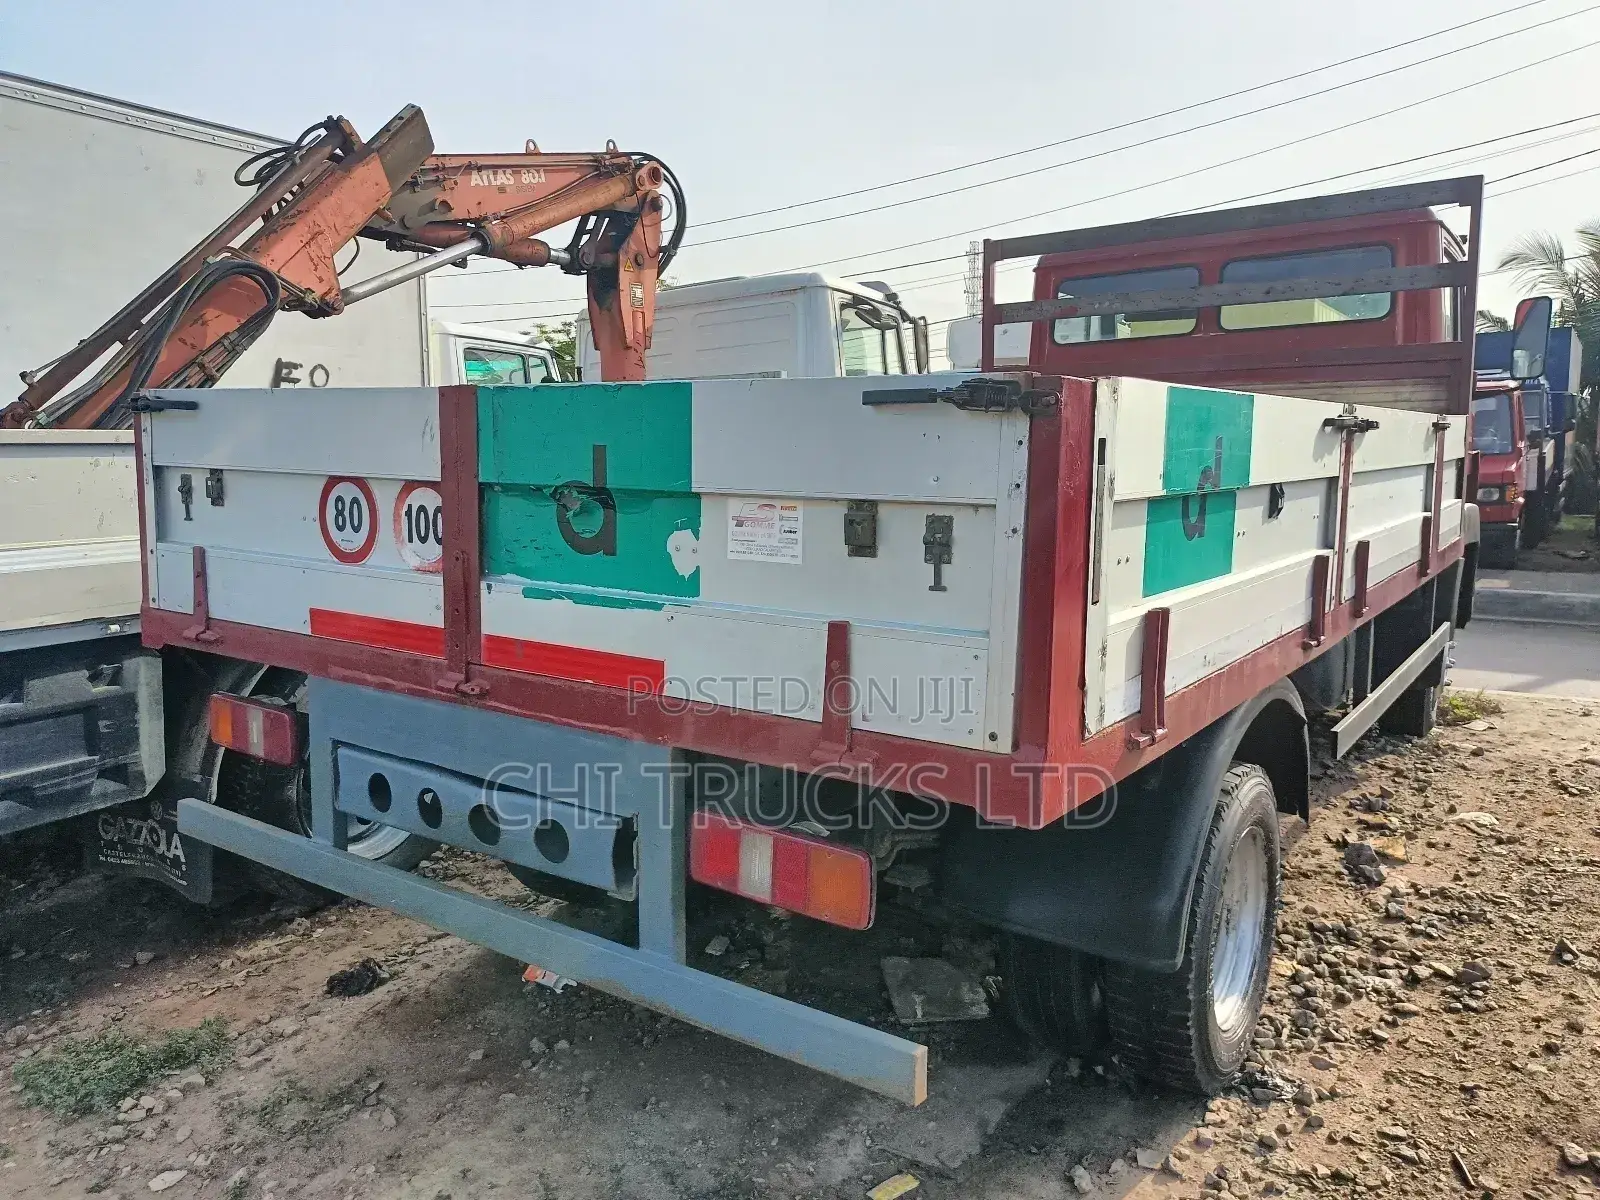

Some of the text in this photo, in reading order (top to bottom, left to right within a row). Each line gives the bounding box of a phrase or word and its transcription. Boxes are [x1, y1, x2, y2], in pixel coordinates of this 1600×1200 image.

[470, 168, 546, 186] ATLAS 80.1
[334, 495, 363, 533] 80
[405, 504, 443, 545] 100
